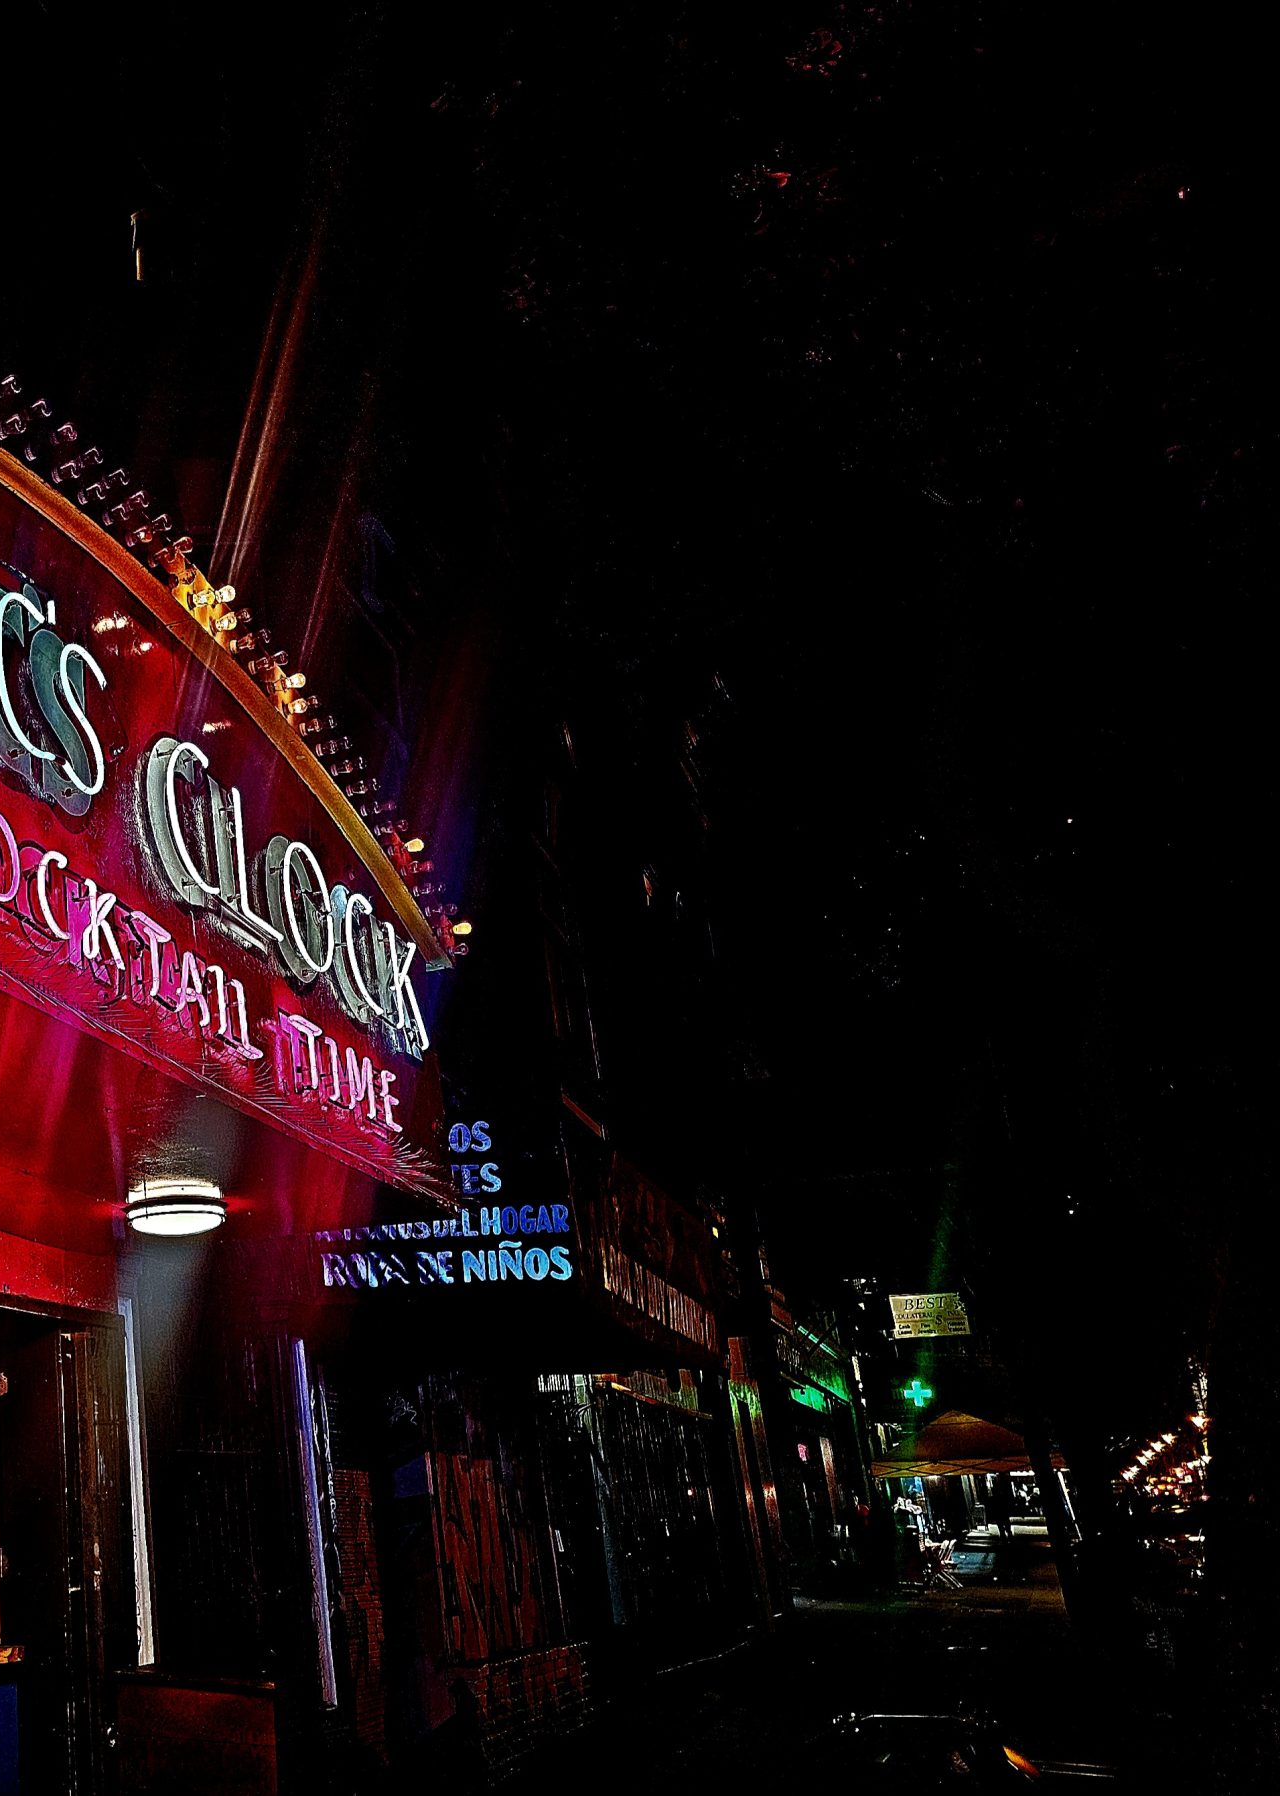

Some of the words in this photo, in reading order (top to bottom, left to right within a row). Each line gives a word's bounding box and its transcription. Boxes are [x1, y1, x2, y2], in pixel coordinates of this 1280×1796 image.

[147, 738, 430, 1060] CLOCK
[279, 1010, 403, 1140] TIME
[480, 1204, 570, 1237] HOGAR
[461, 1240, 574, 1284] NIÑOS
[904, 1296, 947, 1311] BEST
